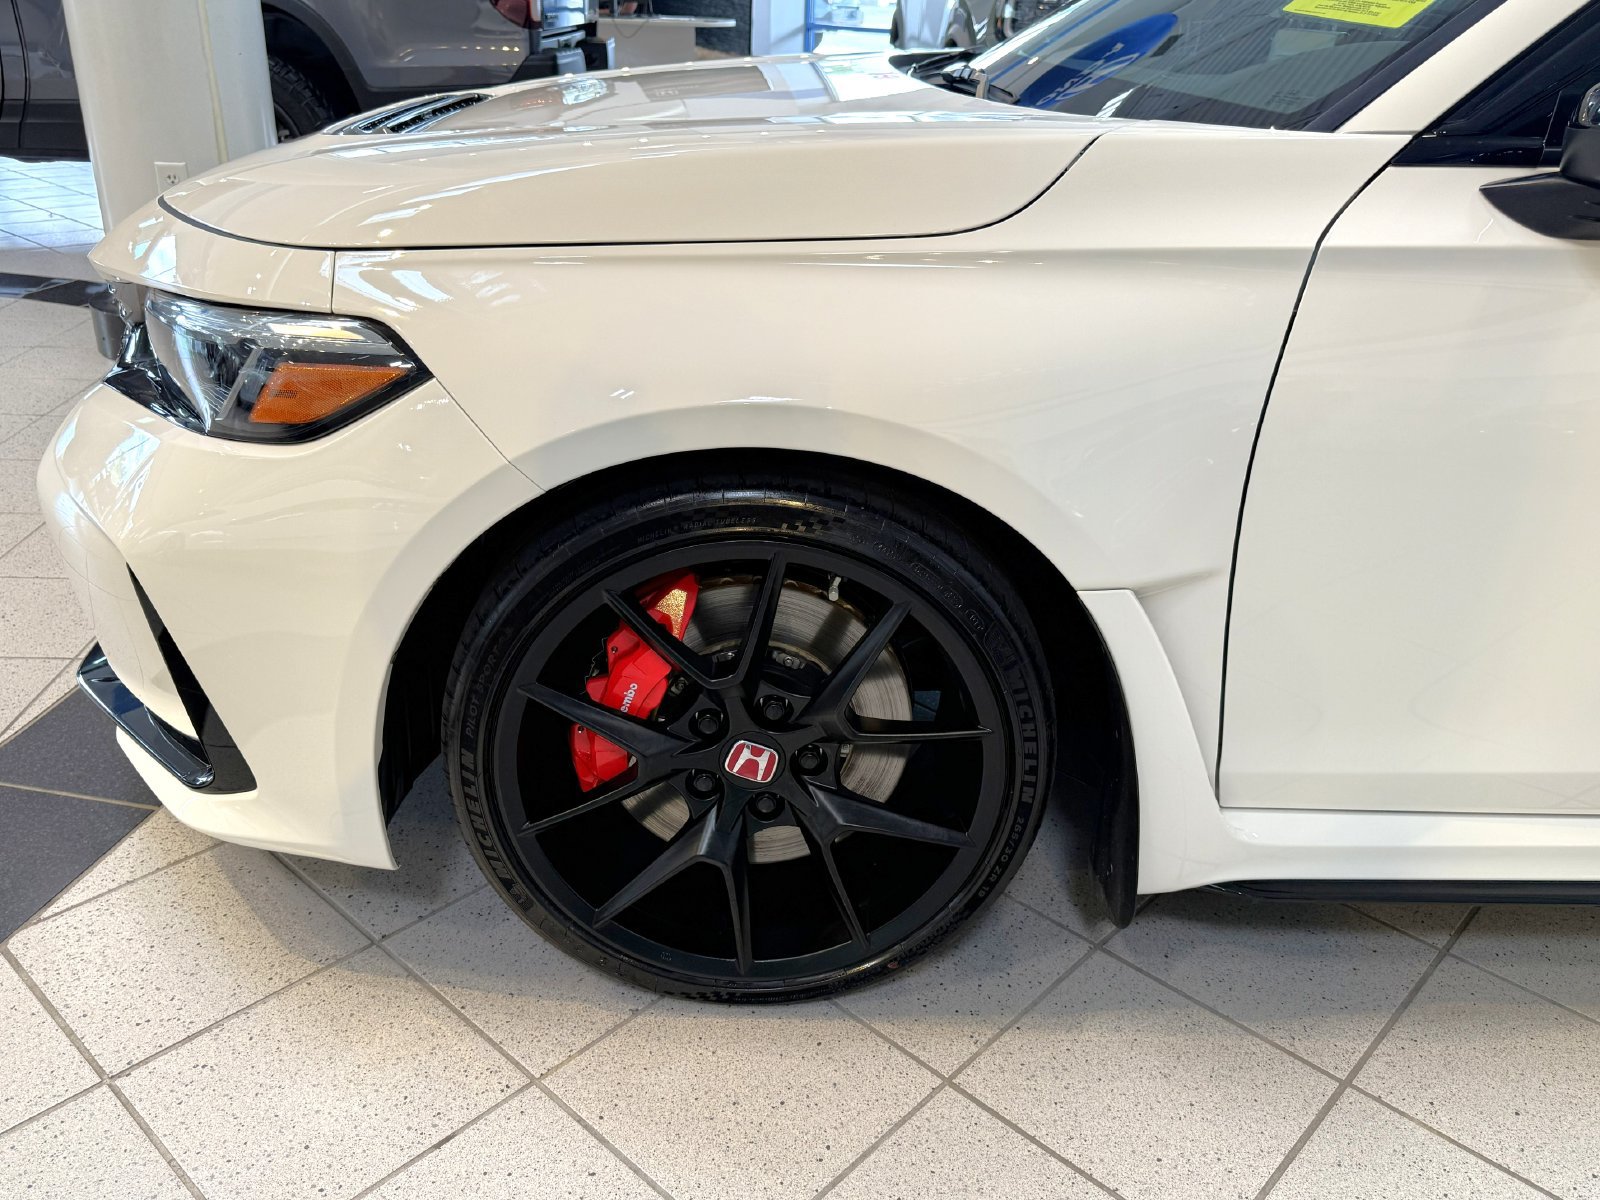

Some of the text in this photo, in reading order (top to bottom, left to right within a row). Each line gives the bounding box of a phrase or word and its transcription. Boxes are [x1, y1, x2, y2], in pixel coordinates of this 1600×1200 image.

[715, 516, 757, 527] TUBELESS
[475, 644, 500, 693] SPORT
[464, 695, 480, 738] PILOT
[620, 682, 638, 713] embo
[1005, 667, 1038, 804] MICHELIN
[461, 749, 512, 880] MICHELIN
[1000, 815, 1025, 863] 265/30
